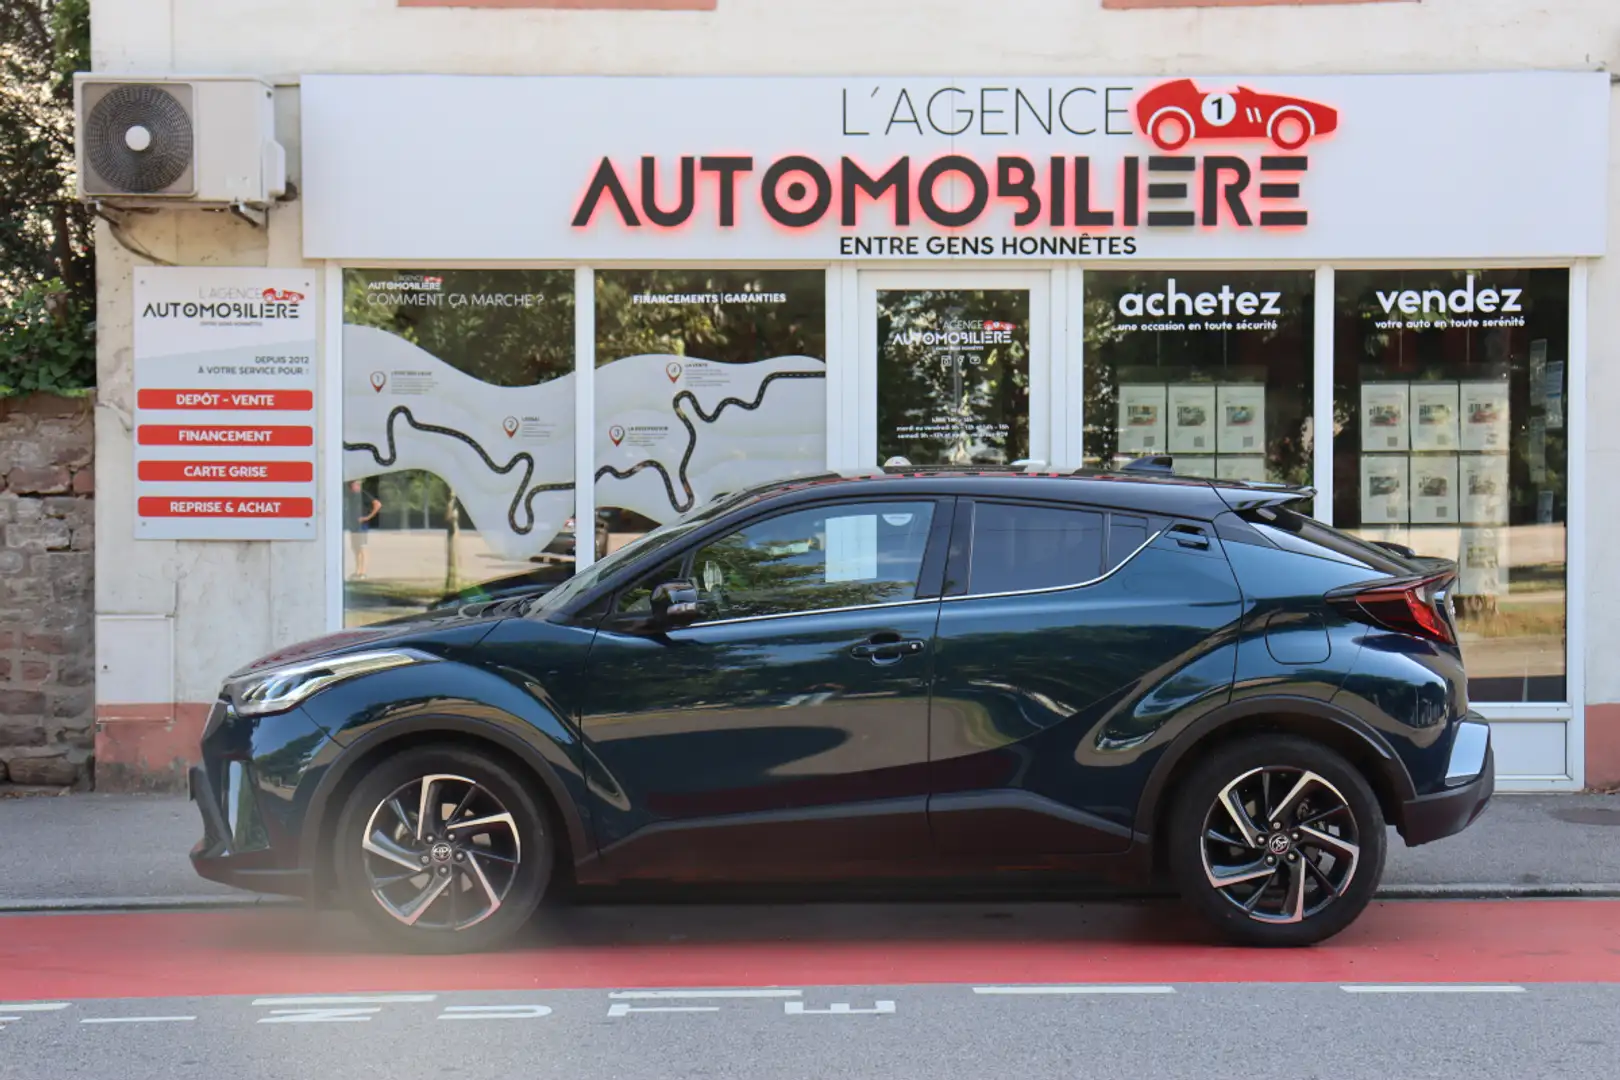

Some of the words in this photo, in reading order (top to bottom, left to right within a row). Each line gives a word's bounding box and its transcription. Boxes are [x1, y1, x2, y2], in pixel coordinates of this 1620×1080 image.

[842, 86, 1134, 136] L'AGENCE
[1211, 97, 1224, 120] 1
[840, 236, 918, 254] ENTRE
[926, 236, 994, 254] GENS
[1002, 233, 1137, 254] HONNÊTES
[633, 294, 718, 304] FINANCEMENTS
[724, 293, 787, 303] GARANTIES
[1118, 278, 1282, 317] achetez
[1375, 274, 1523, 313] vendez
[367, 293, 445, 306] COMMENT
[448, 293, 468, 308] ÇA
[471, 293, 533, 307] MARCHE
[1143, 320, 1185, 331] occasion
[1189, 322, 1201, 331] en
[1204, 321, 1233, 330] toute
[1236, 319, 1278, 330] sécurité
[1375, 319, 1403, 329] votre
[1406, 319, 1431, 328] auto
[1434, 319, 1447, 328] en
[1451, 317, 1480, 327] toute
[255, 356, 287, 364] DEPUIS
[289, 356, 309, 364] 2012
[208, 367, 238, 375] VOTRE
[239, 367, 276, 375] SERVICE
[278, 367, 303, 375] POUR
[176, 392, 220, 405] DEPÔT
[232, 394, 274, 405] VENTE
[178, 430, 272, 442] FINANCEMENT
[184, 466, 226, 477] CARTE
[229, 466, 268, 478] GRISE
[170, 502, 222, 513] REPRISE
[225, 502, 234, 513] &
[237, 502, 281, 513] ACHAT
